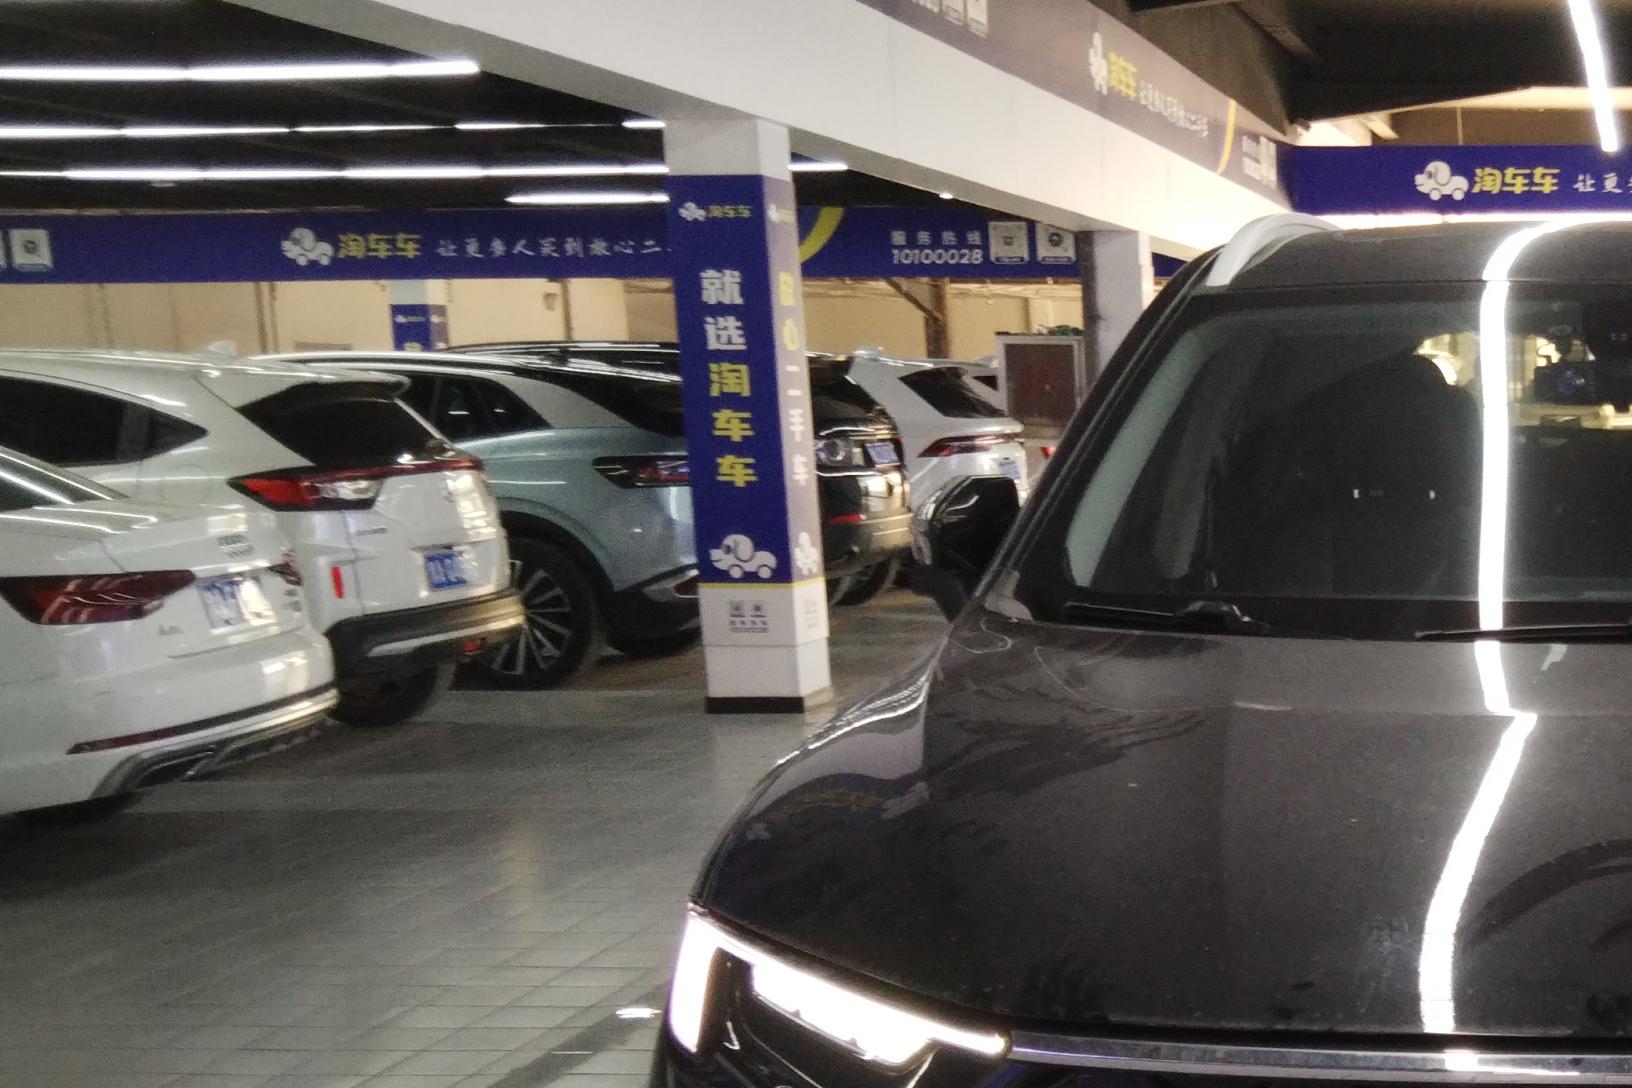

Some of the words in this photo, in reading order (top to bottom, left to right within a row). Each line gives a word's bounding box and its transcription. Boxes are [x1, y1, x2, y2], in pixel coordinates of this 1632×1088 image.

[1472, 166, 1561, 194] 淘车车
[337, 233, 421, 259] 淘车车
[892, 249, 983, 265] 10100028
[699, 269, 758, 488] 就选淘车车
